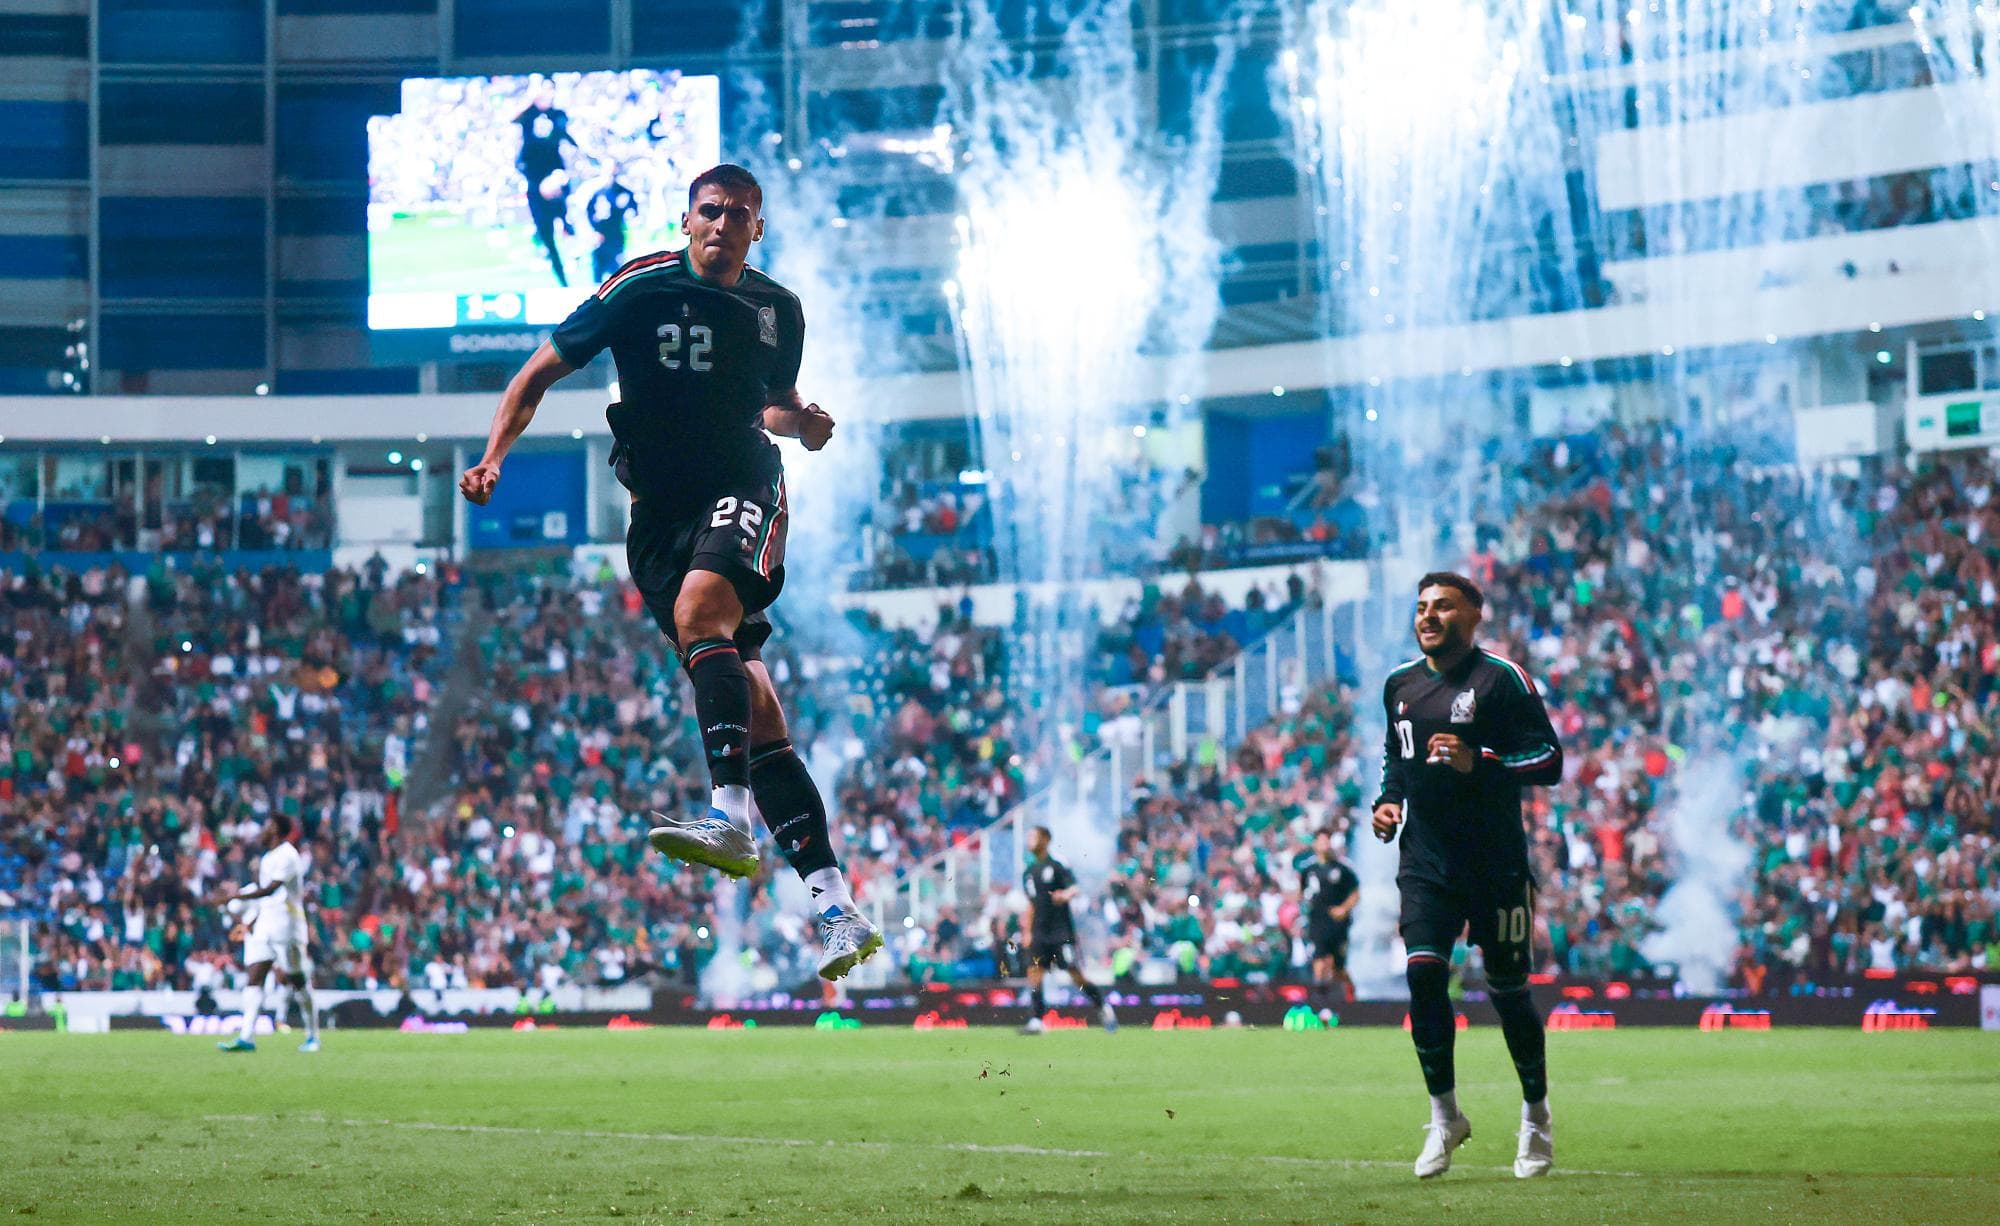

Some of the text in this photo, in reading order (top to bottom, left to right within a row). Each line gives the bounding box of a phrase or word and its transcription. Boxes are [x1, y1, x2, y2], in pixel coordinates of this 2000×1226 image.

[657, 324, 713, 371] 22
[711, 496, 763, 538] 22
[707, 723, 748, 733] MÉXICO
[1497, 906, 1525, 942] 10
